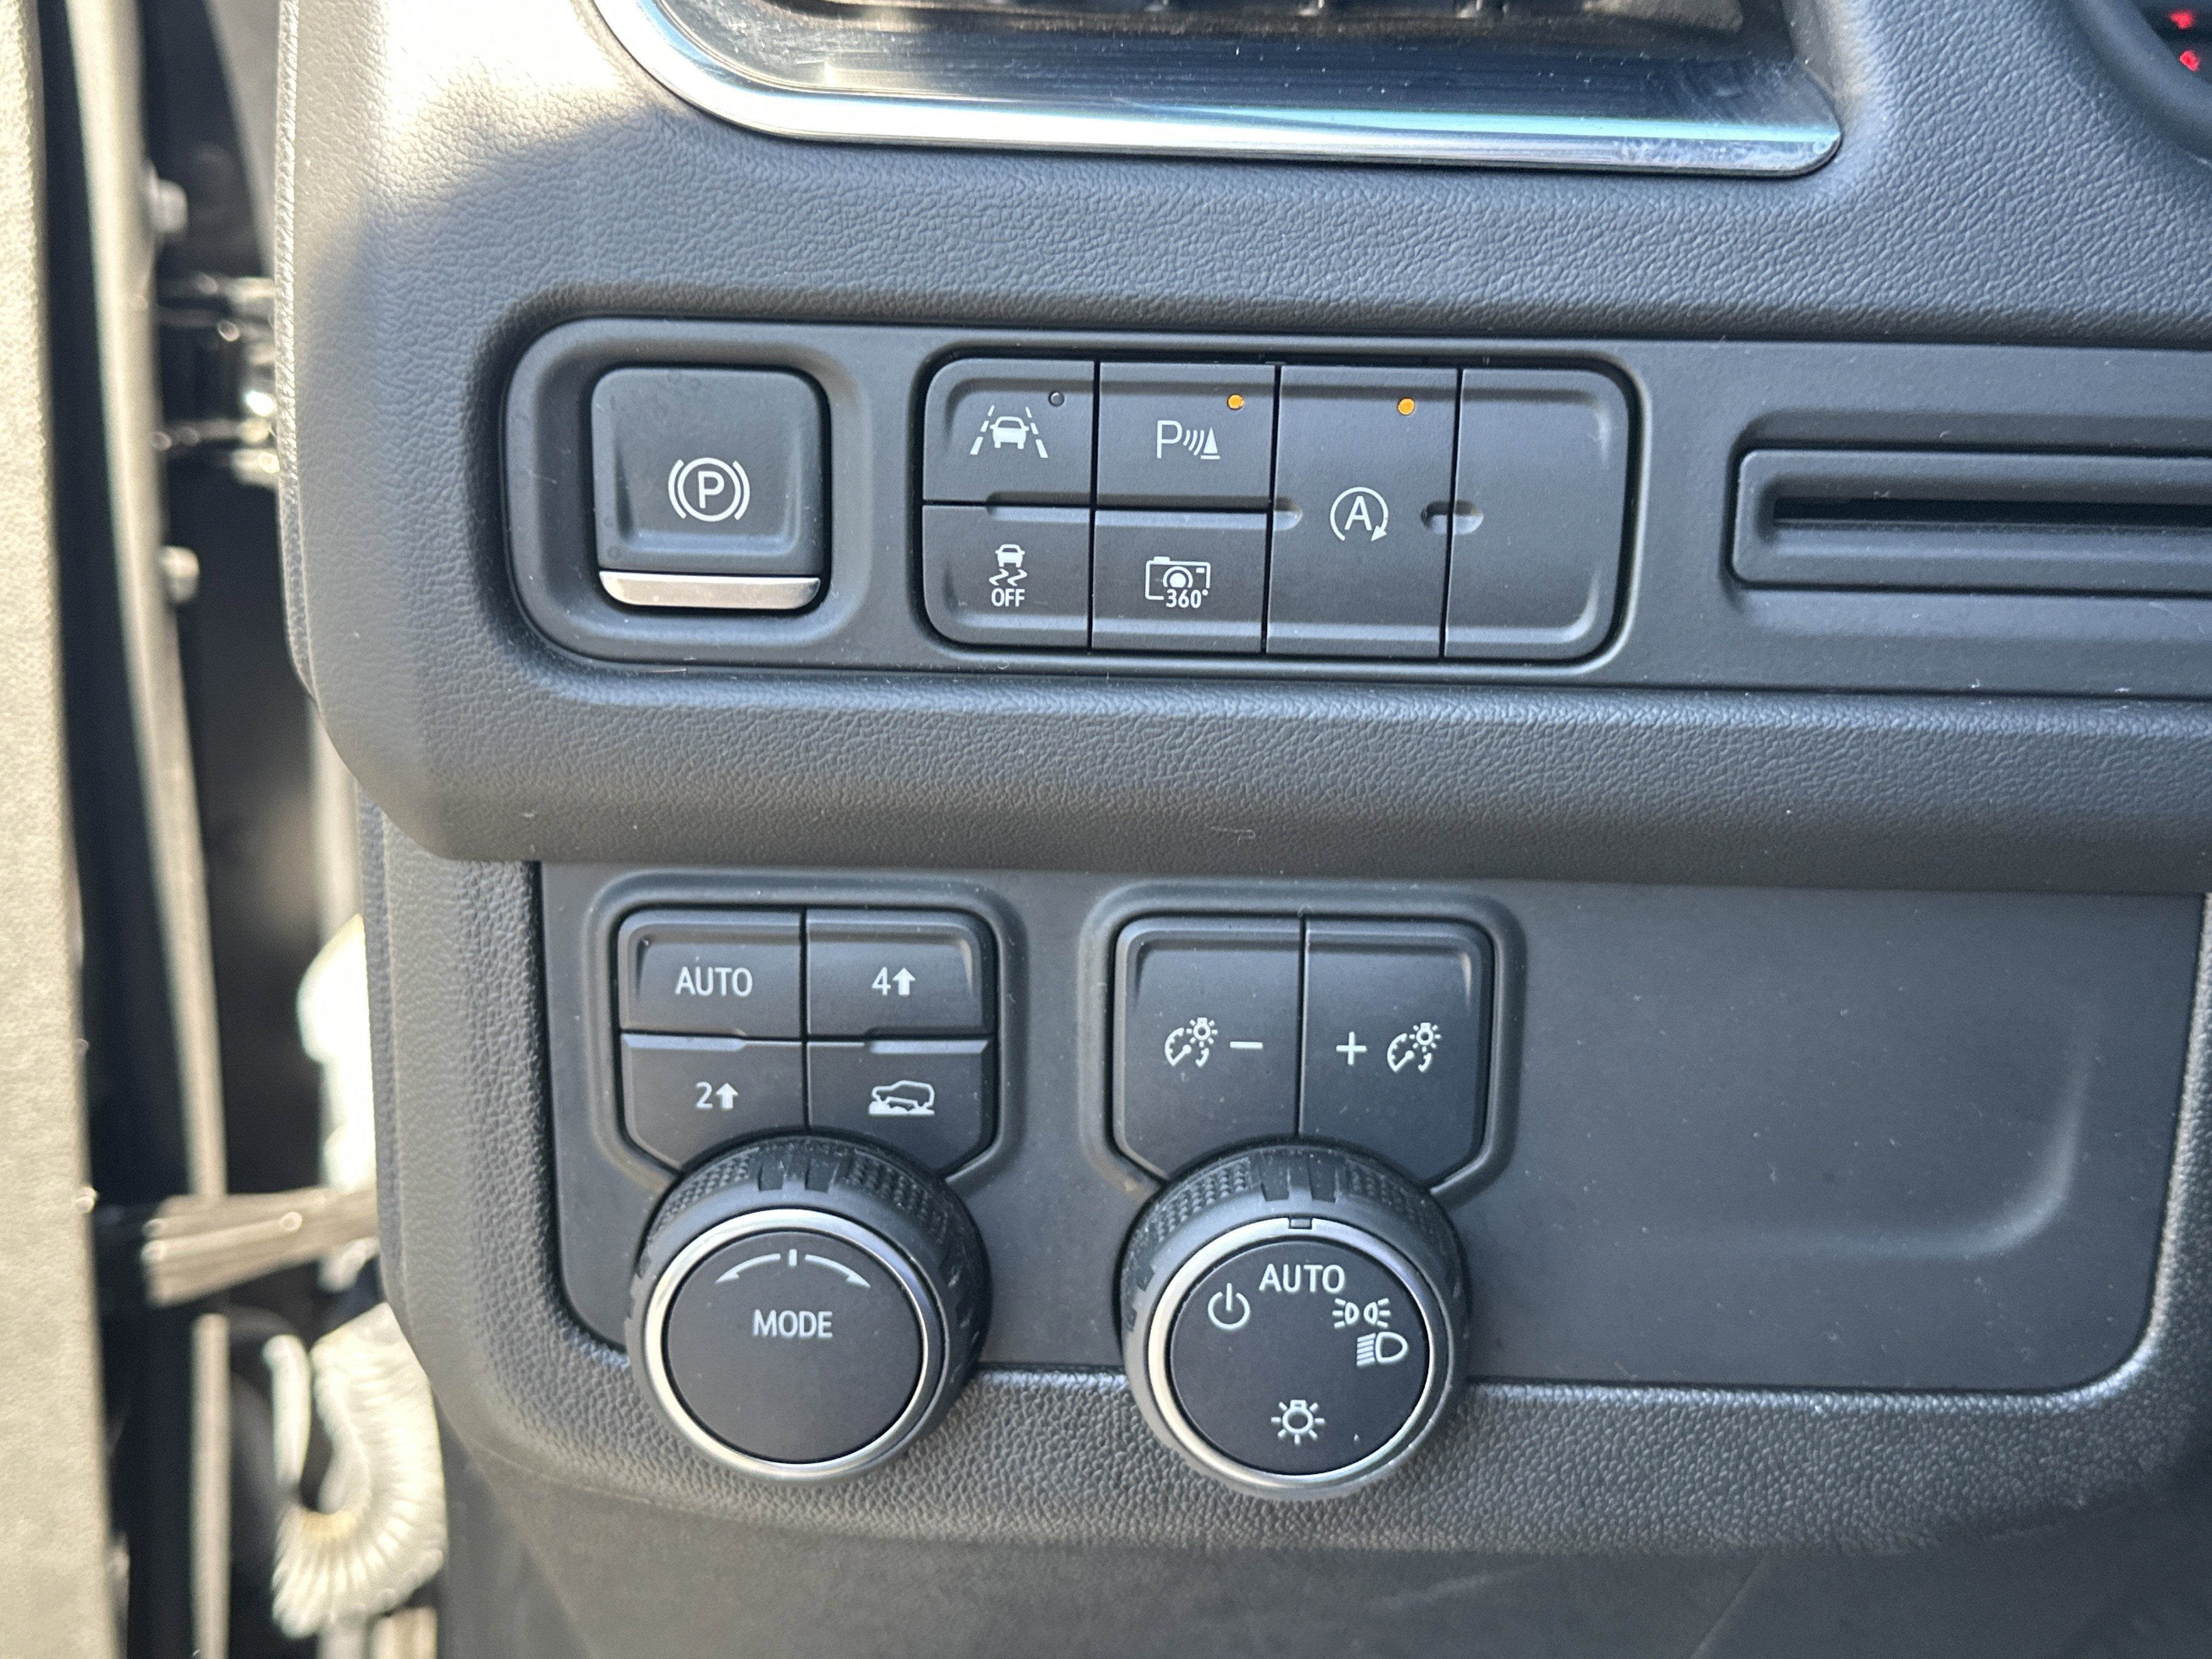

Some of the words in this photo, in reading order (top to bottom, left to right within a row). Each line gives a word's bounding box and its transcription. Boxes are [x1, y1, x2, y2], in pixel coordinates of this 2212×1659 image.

[991, 588, 1025, 607] OFF
[674, 966, 753, 997] AUTO
[1259, 1263, 1345, 1294] AUTO
[752, 1308, 833, 1339] MODE
